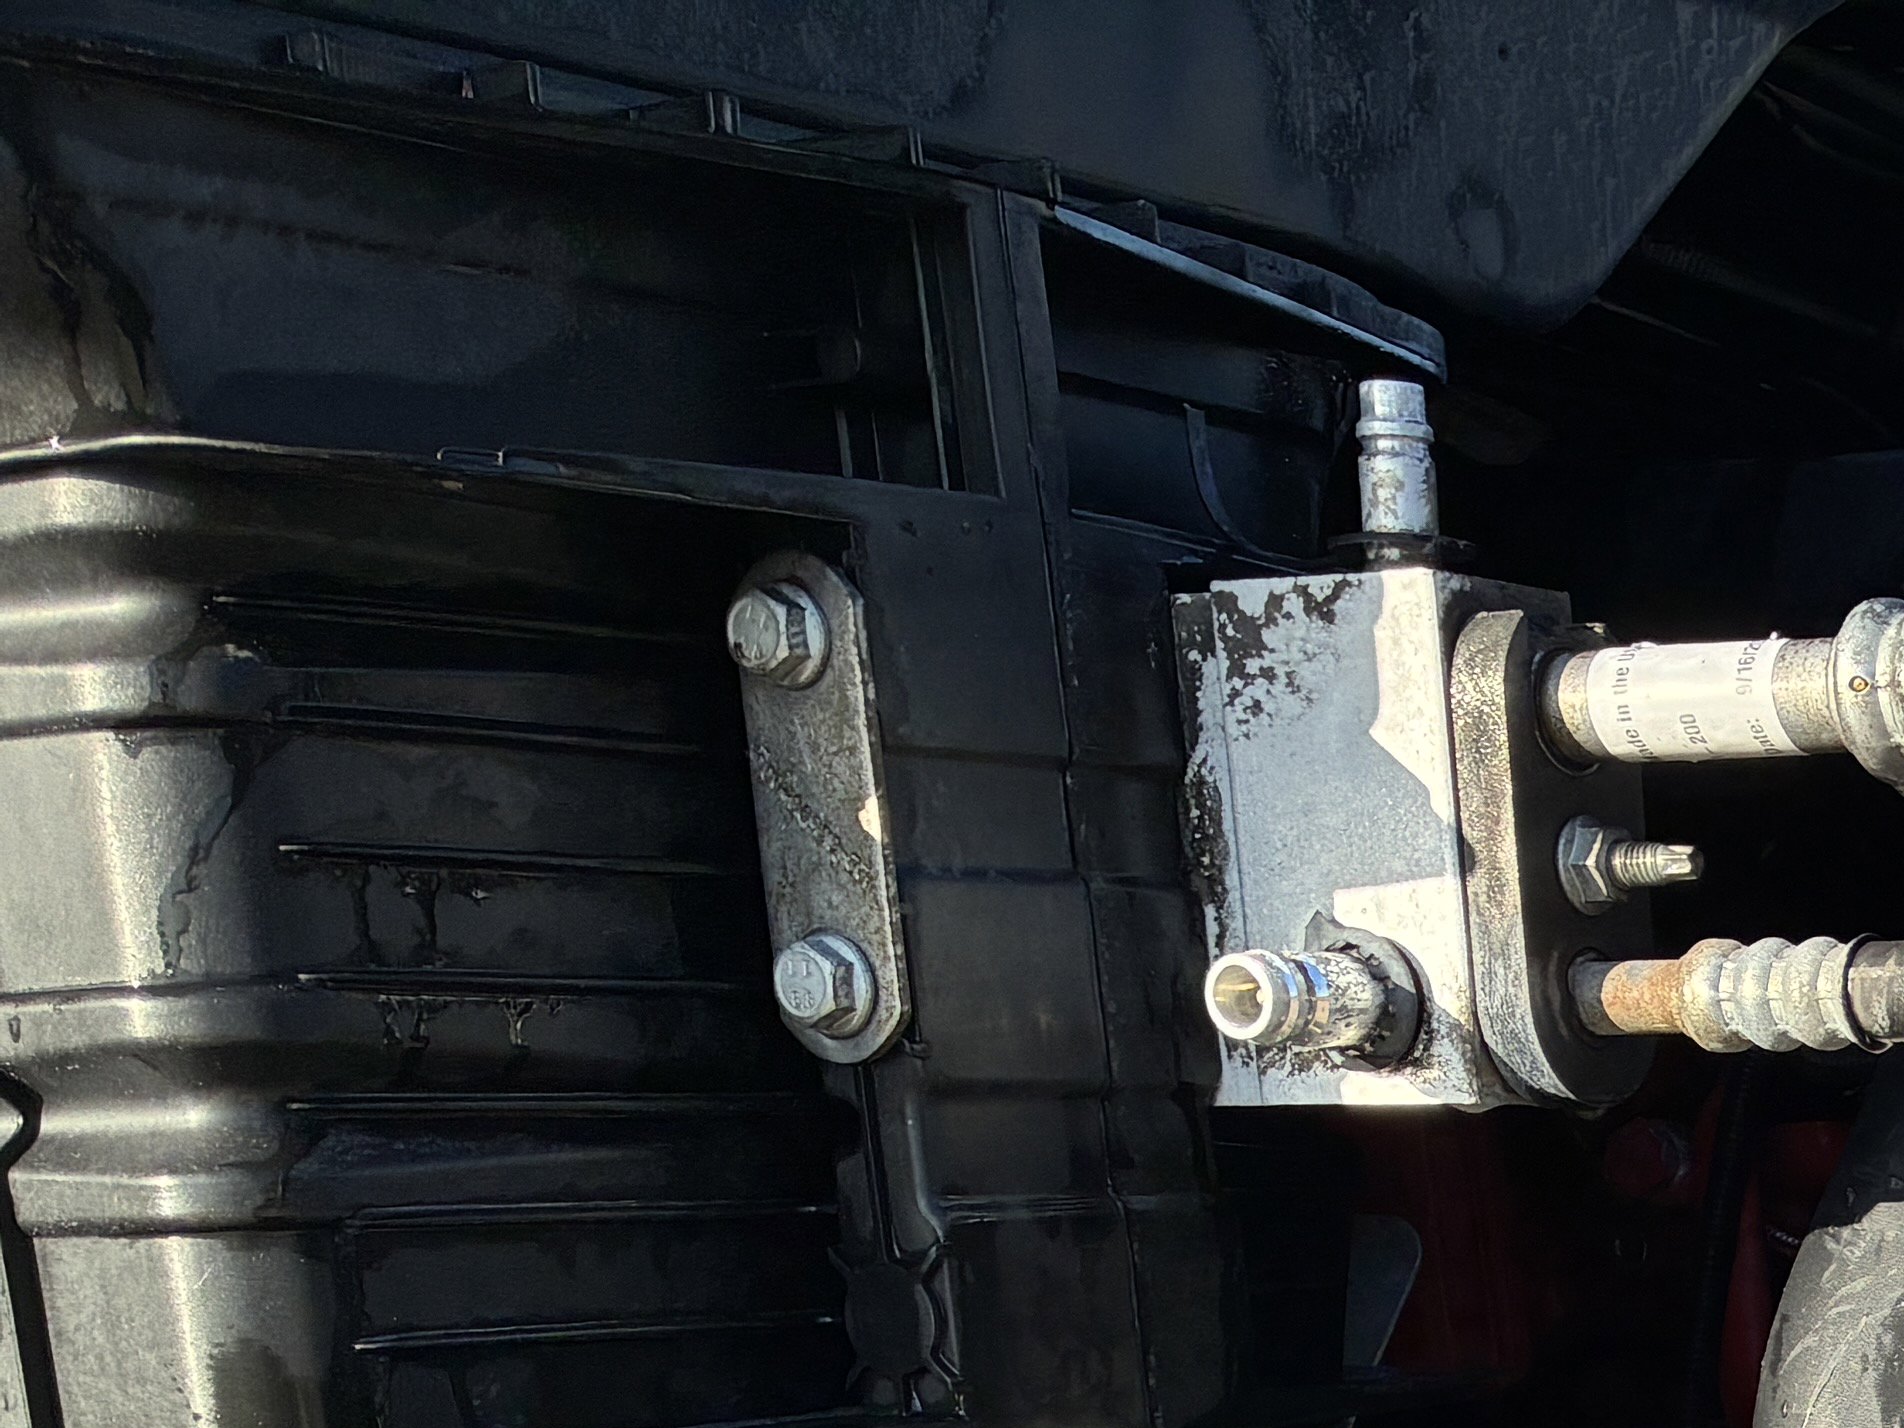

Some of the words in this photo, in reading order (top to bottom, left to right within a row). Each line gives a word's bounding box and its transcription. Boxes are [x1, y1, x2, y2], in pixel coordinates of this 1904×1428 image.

[1611, 666, 1630, 696] the
[1616, 703, 1633, 722] in
[1625, 728, 1659, 760] ade
